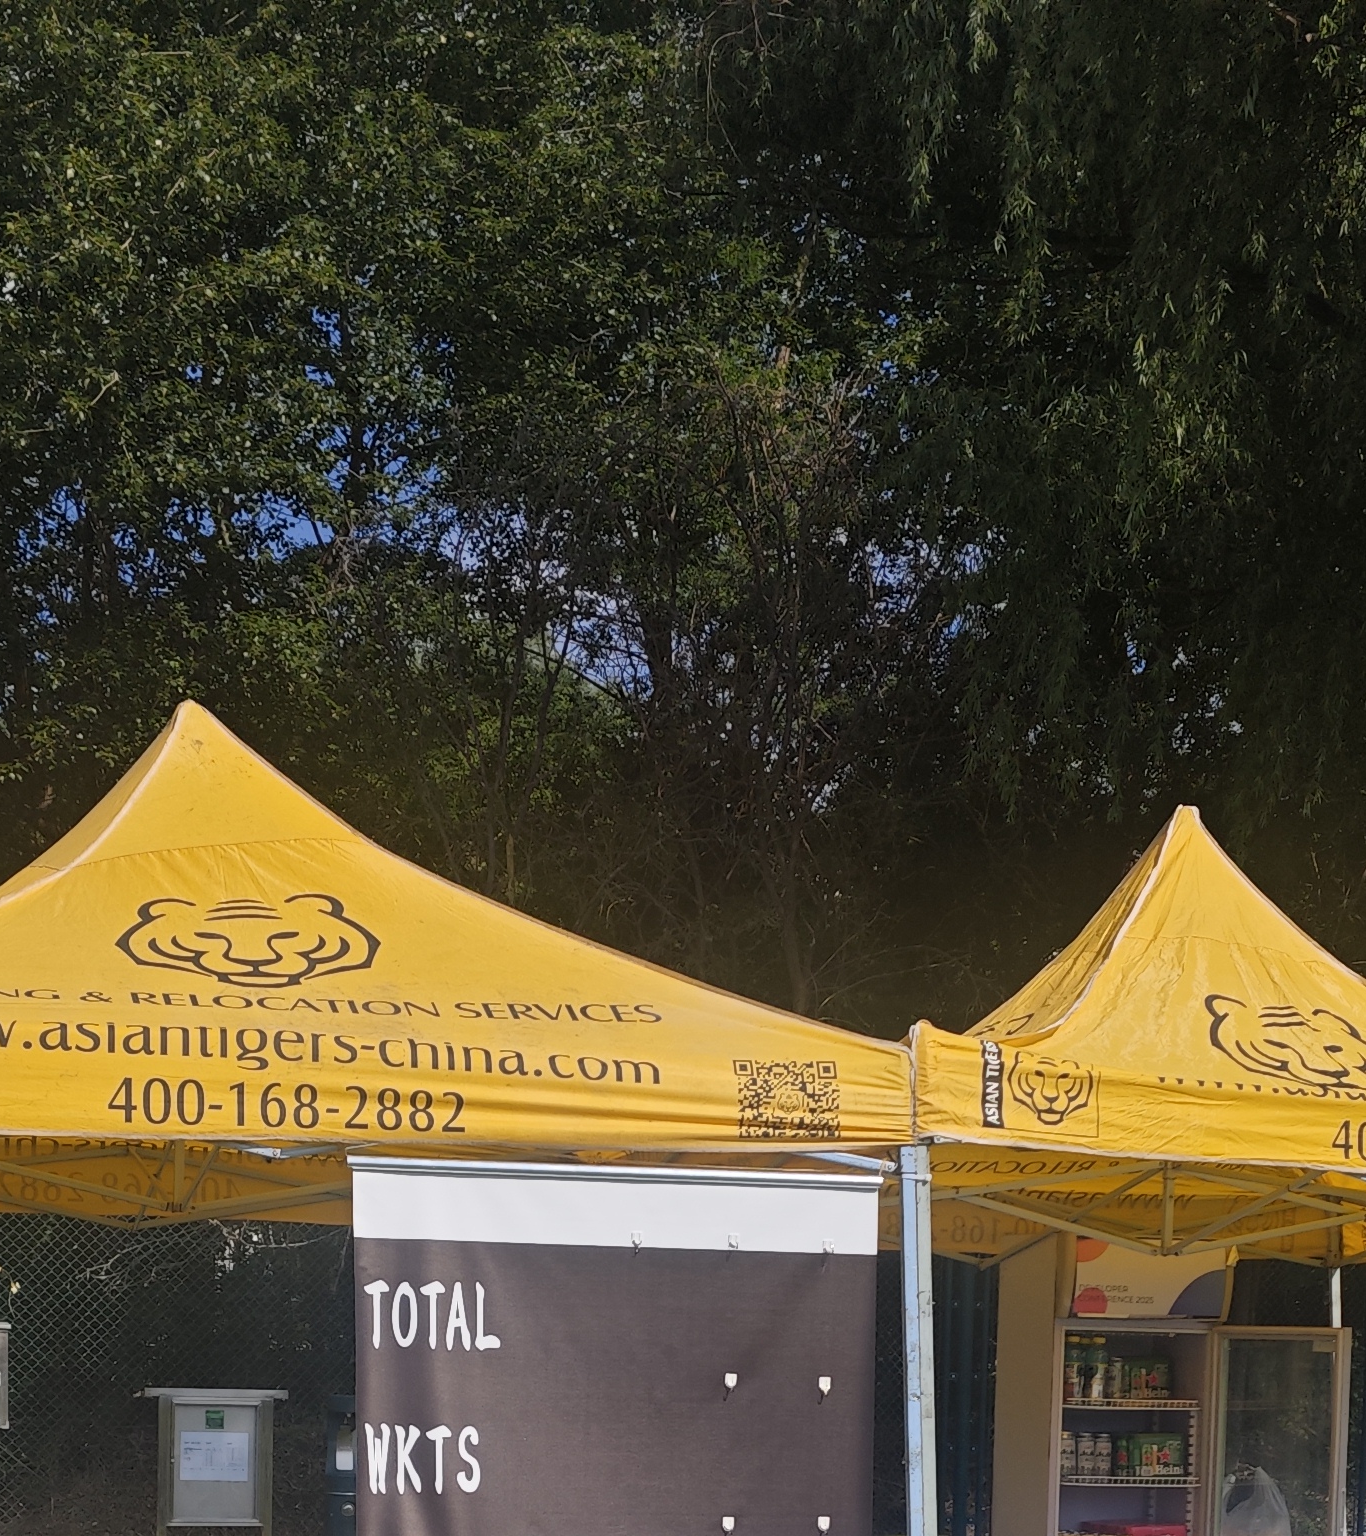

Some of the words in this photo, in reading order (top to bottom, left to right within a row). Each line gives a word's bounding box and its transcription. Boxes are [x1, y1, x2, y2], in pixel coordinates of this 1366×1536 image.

[80, 991, 113, 1003] &
[130, 991, 441, 1018] RELOCATION
[455, 1001, 663, 1023] SERVICES
[108, 1077, 467, 1134] 400-168-2882
[984, 1081, 1000, 1125] ASIAN
[363, 1280, 501, 1352] TOTAL
[364, 1422, 482, 1496] WKTS
